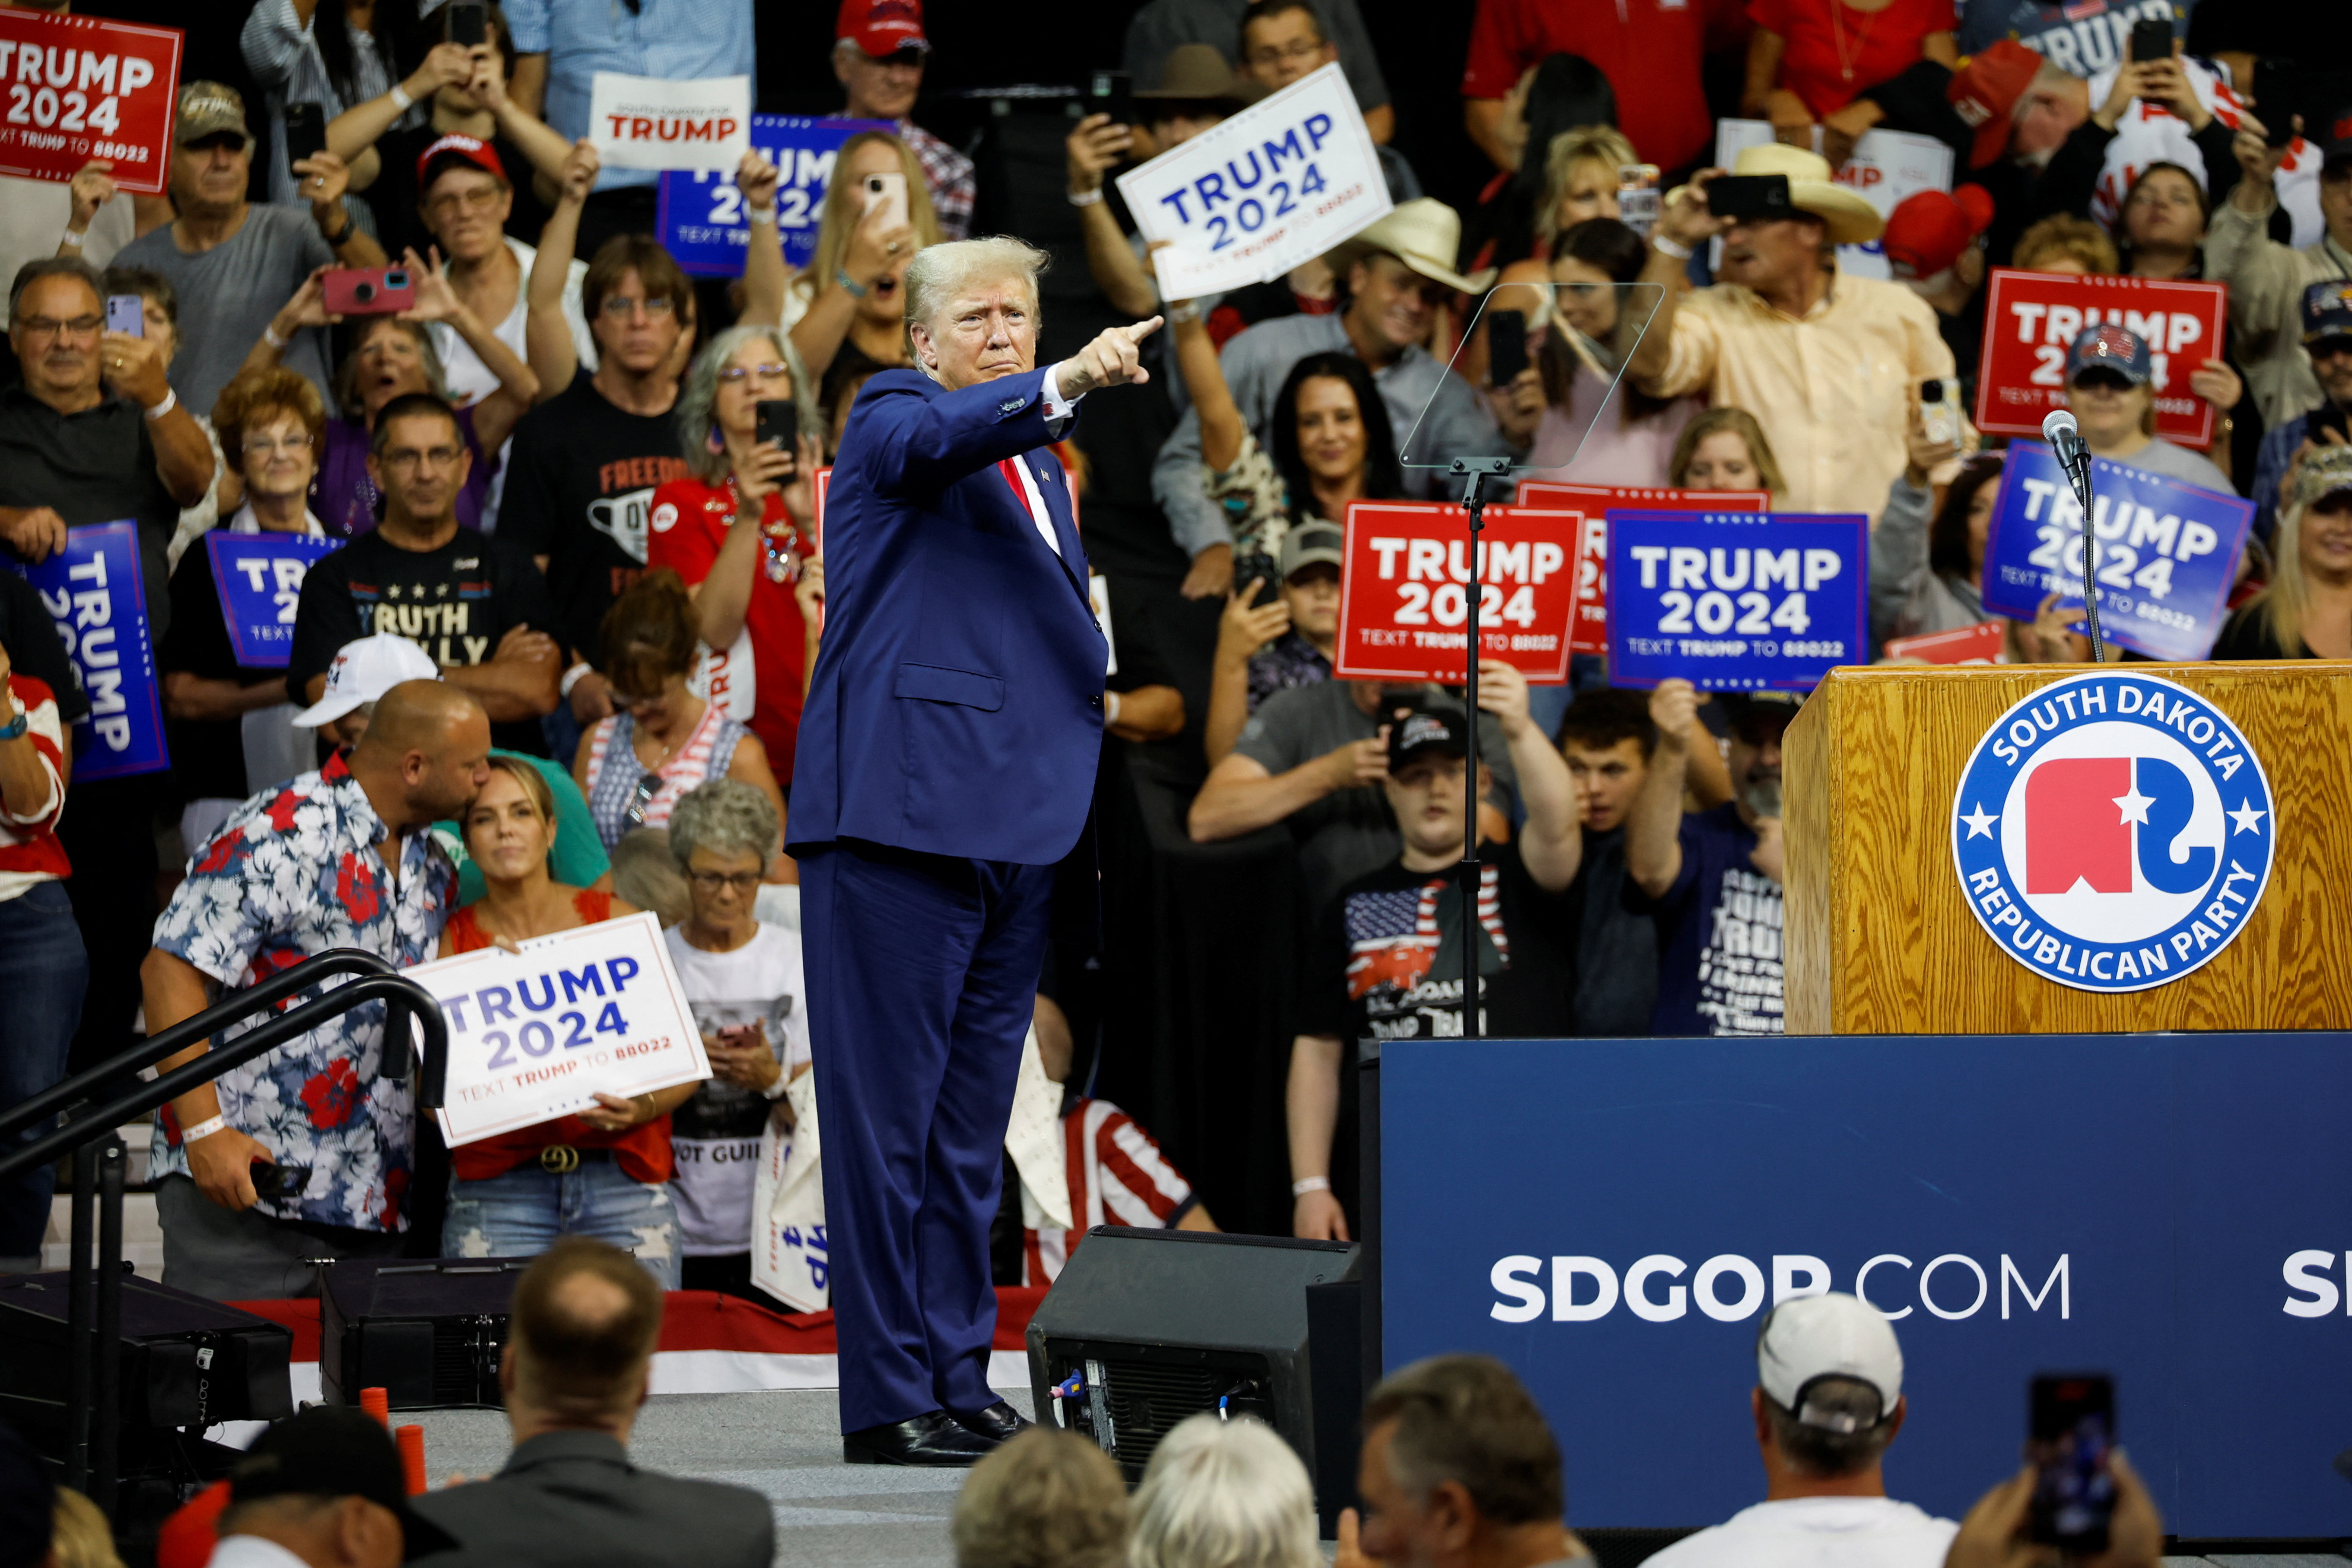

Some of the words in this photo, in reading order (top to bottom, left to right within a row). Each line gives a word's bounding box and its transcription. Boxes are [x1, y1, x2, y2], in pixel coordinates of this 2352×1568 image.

[0, 39, 154, 97] TRUMP
[7, 82, 120, 136] 2024
[606, 113, 738, 143] TRUMP
[20, 130, 66, 151] TRUMP
[93, 140, 149, 163] 88022
[1160, 113, 1333, 225] TRUMP
[1206, 162, 1326, 251] 2024
[1231, 227, 1286, 261] TRUMP
[2022, 478, 2218, 563] TRUMP
[1369, 537, 1564, 584] TRUMP
[1630, 546, 1842, 591] TRUMP
[2027, 524, 2175, 600] 2024
[357, 601, 469, 638] TRUTH
[1394, 582, 1536, 628] 2024
[1658, 591, 1811, 635] 2024
[2000, 565, 2038, 587] TEXT
[2108, 591, 2134, 613] TO
[2135, 601, 2196, 632] 88022
[69, 551, 131, 752] TRUMP
[250, 625, 294, 641] TEXT
[1360, 628, 1409, 647] TEXT
[1415, 631, 1481, 649] TRUM
[1486, 633, 1509, 651] TO
[1511, 635, 1558, 651] 88022
[1627, 637, 1674, 656] TEXT
[1677, 640, 1748, 657] TRUMP
[1750, 640, 1779, 657] TO
[1782, 641, 1844, 657] 88022
[1992, 686, 2106, 766] SOUTH
[2117, 685, 2245, 781] DAKOTA
[1969, 867, 2169, 980] REPUBLICAN
[2170, 859, 2256, 962] PARTY
[440, 956, 640, 1034] TRUMP
[482, 1001, 629, 1072] 2024
[457, 1077, 506, 1103] TEXT
[513, 1060, 578, 1089] TRUMP
[583, 1051, 609, 1070] TO
[1490, 1254, 2070, 1322] SDGOPCOM
